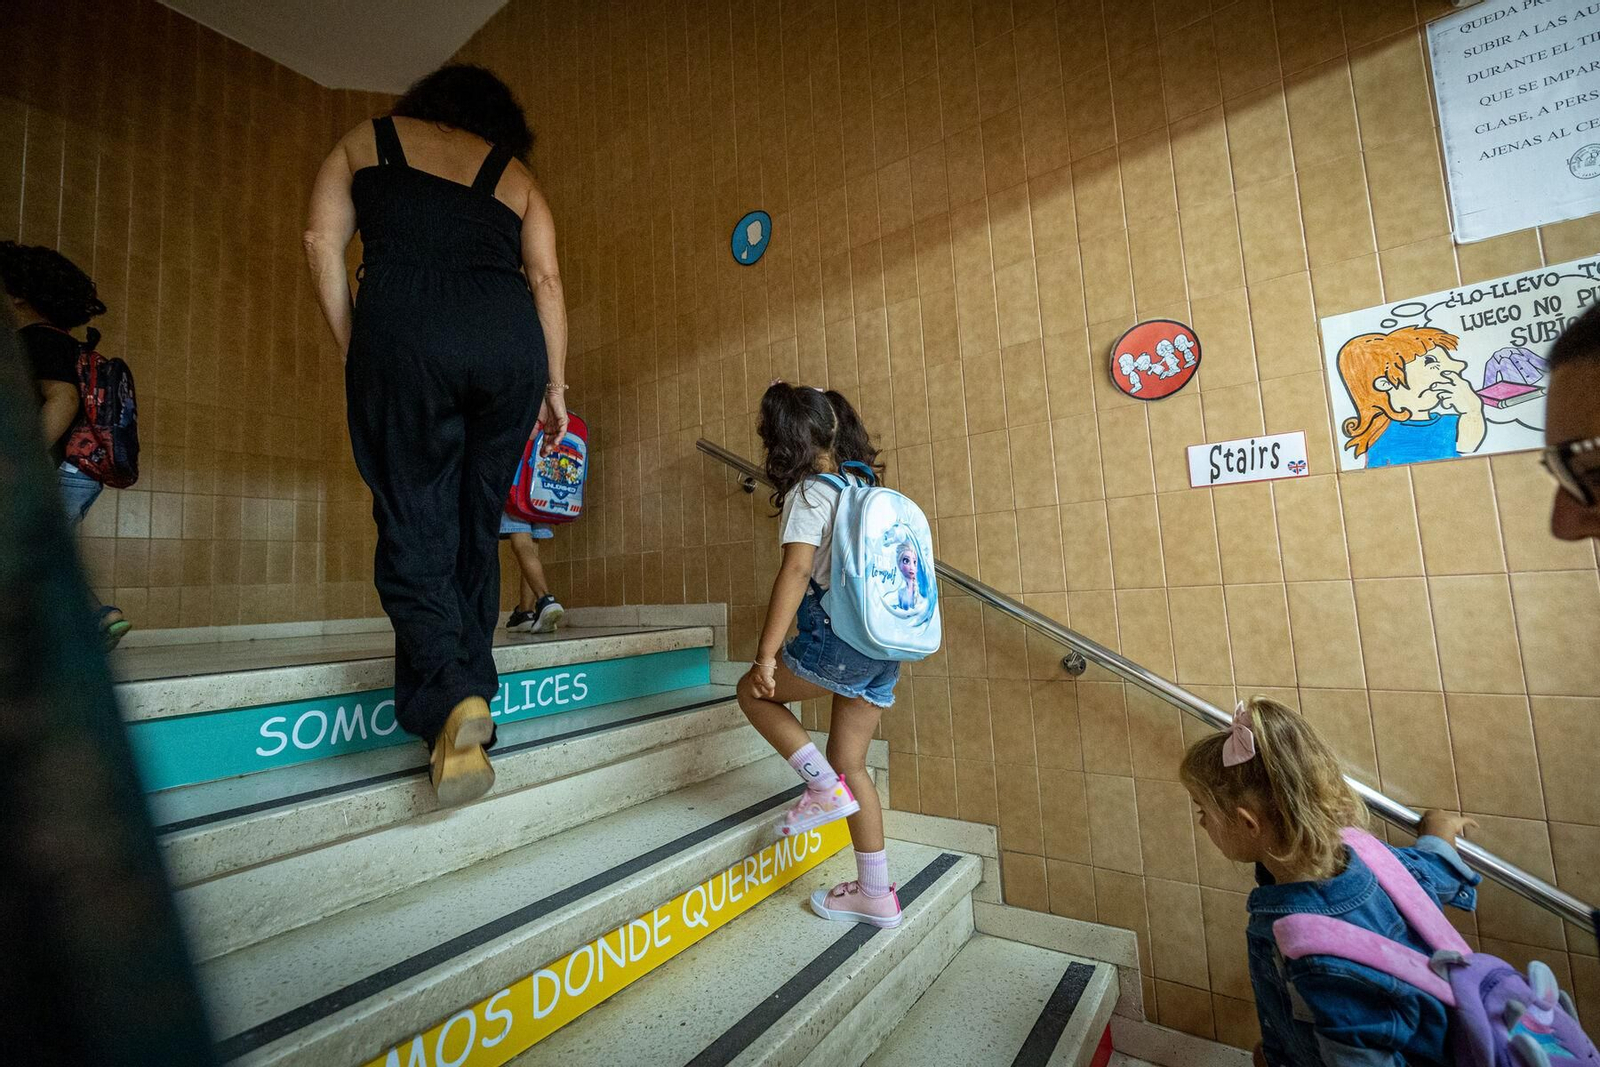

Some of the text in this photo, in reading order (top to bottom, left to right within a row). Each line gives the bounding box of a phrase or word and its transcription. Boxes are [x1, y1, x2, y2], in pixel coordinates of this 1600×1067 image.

[1459, 5, 1518, 34] QUEDA
[1463, 35, 1512, 58] SUBIR
[1517, 29, 1529, 40] A
[1533, 15, 1568, 34] LAS
[1466, 49, 1548, 84] DURANTE
[1551, 41, 1575, 56] EL
[1474, 89, 1600, 135] CLASE, A PERS
[1479, 88, 1514, 107] QUE
[1518, 80, 1539, 94] SE
[1479, 134, 1543, 161] AJENAS
[1547, 127, 1572, 142] AL
[1491, 272, 1560, 299] LLEVO
[1578, 261, 1600, 279] T
[1460, 304, 1522, 332] LUEGO
[1533, 295, 1562, 318] NO
[1209, 439, 1281, 483] Stairs
[255, 699, 398, 757] SOMO
[532, 913, 672, 1020] DONDE
[682, 825, 823, 929] QUEREMOS
